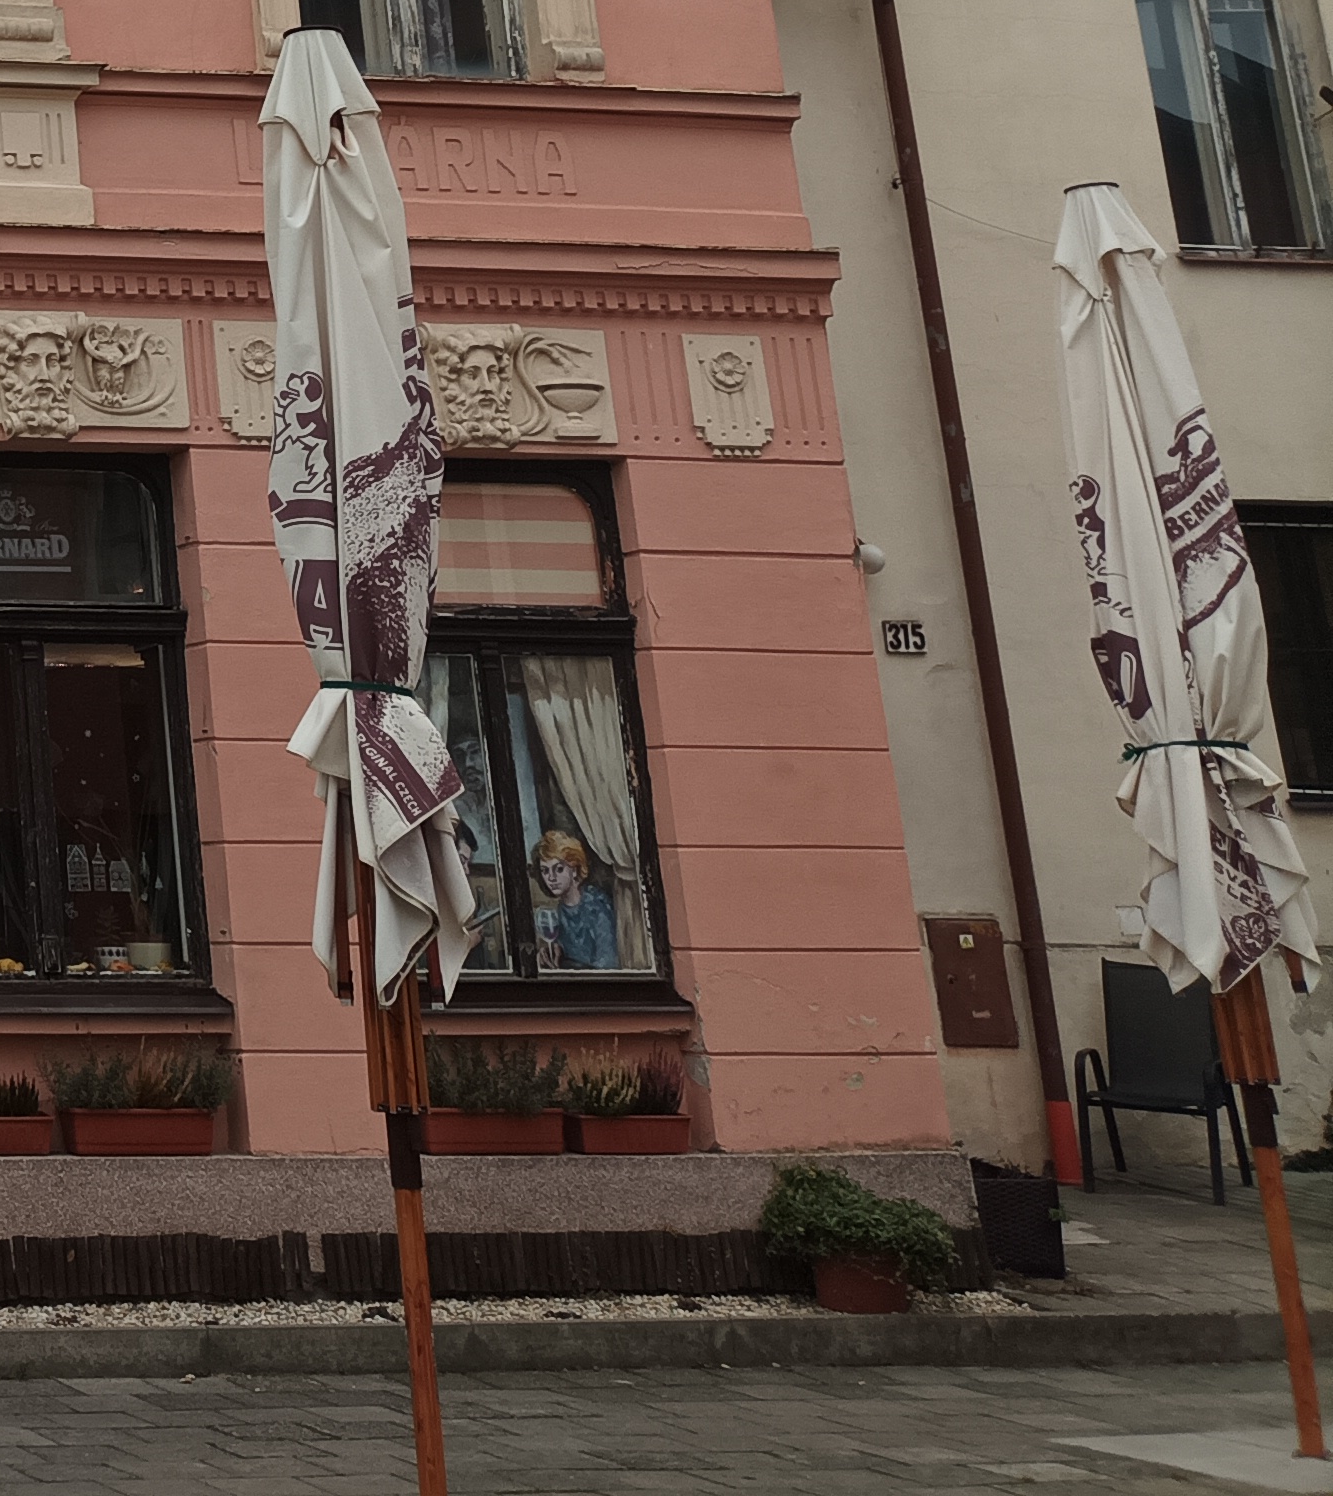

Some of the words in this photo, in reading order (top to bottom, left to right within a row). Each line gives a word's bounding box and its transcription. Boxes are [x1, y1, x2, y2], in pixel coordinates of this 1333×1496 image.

[233, 114, 578, 196] LÁRNA
[1164, 478, 1231, 543] BERNA
[887, 623, 926, 650] 315
[356, 732, 398, 782] RIGINAL
[395, 781, 423, 817] CZECH
